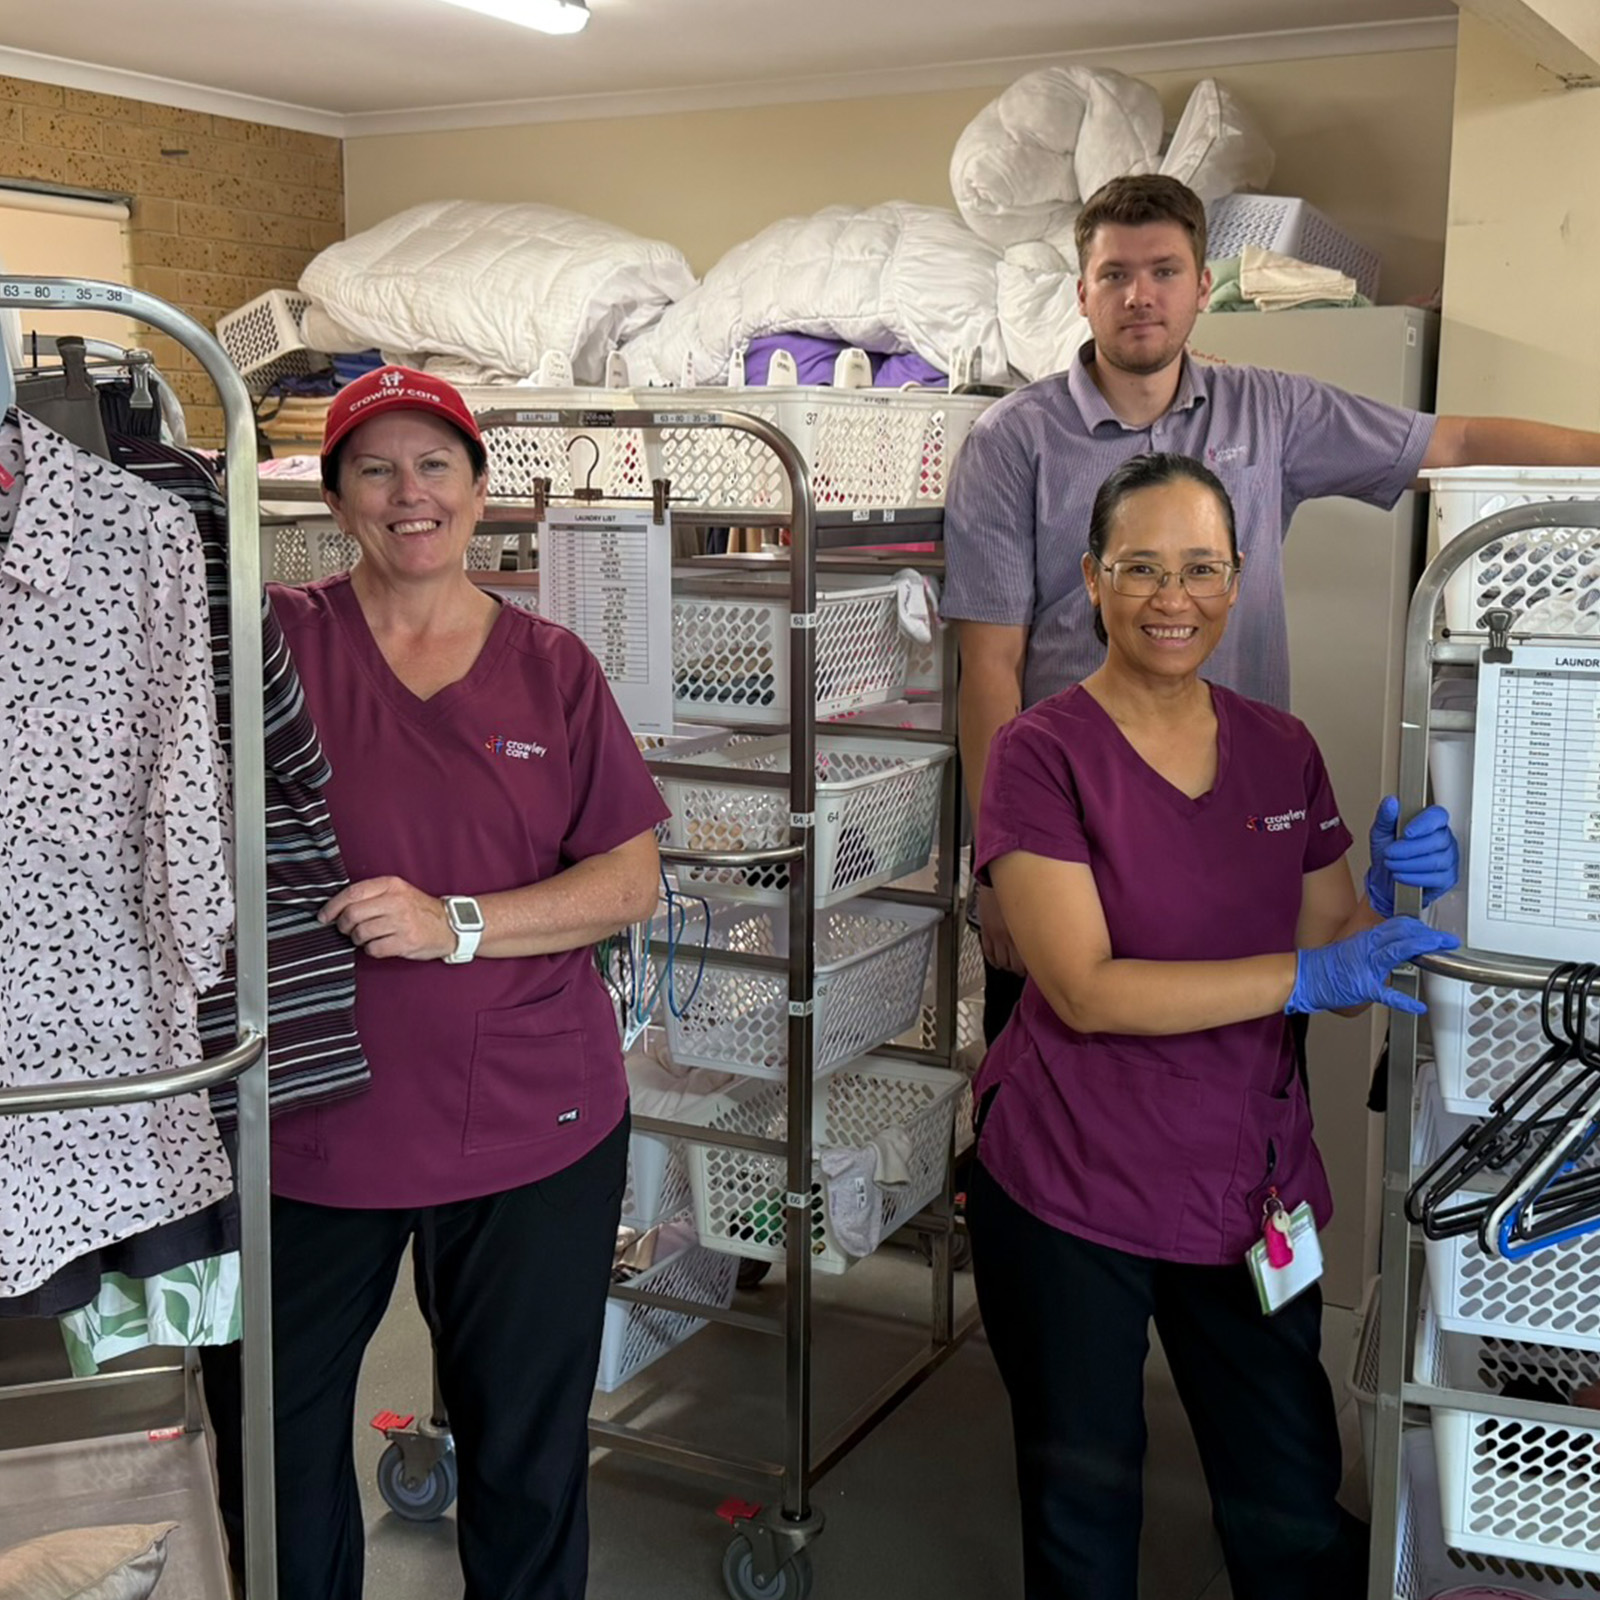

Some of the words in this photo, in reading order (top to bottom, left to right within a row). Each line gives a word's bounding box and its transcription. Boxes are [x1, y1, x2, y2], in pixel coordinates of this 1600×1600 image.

[3, 285, 20, 297] 63
[34, 286, 51, 298] 80
[76, 288, 93, 300] 35
[106, 289, 123, 301] 38
[349, 387, 404, 412] crowley
[407, 388, 441, 402] care
[806, 412, 818, 425] 37
[1555, 657, 1600, 668] LAUNDR
[505, 748, 530, 760] care
[506, 740, 547, 758] crowley
[827, 811, 839, 823] 64
[1264, 809, 1306, 824] crowley
[1267, 822, 1292, 832] care
